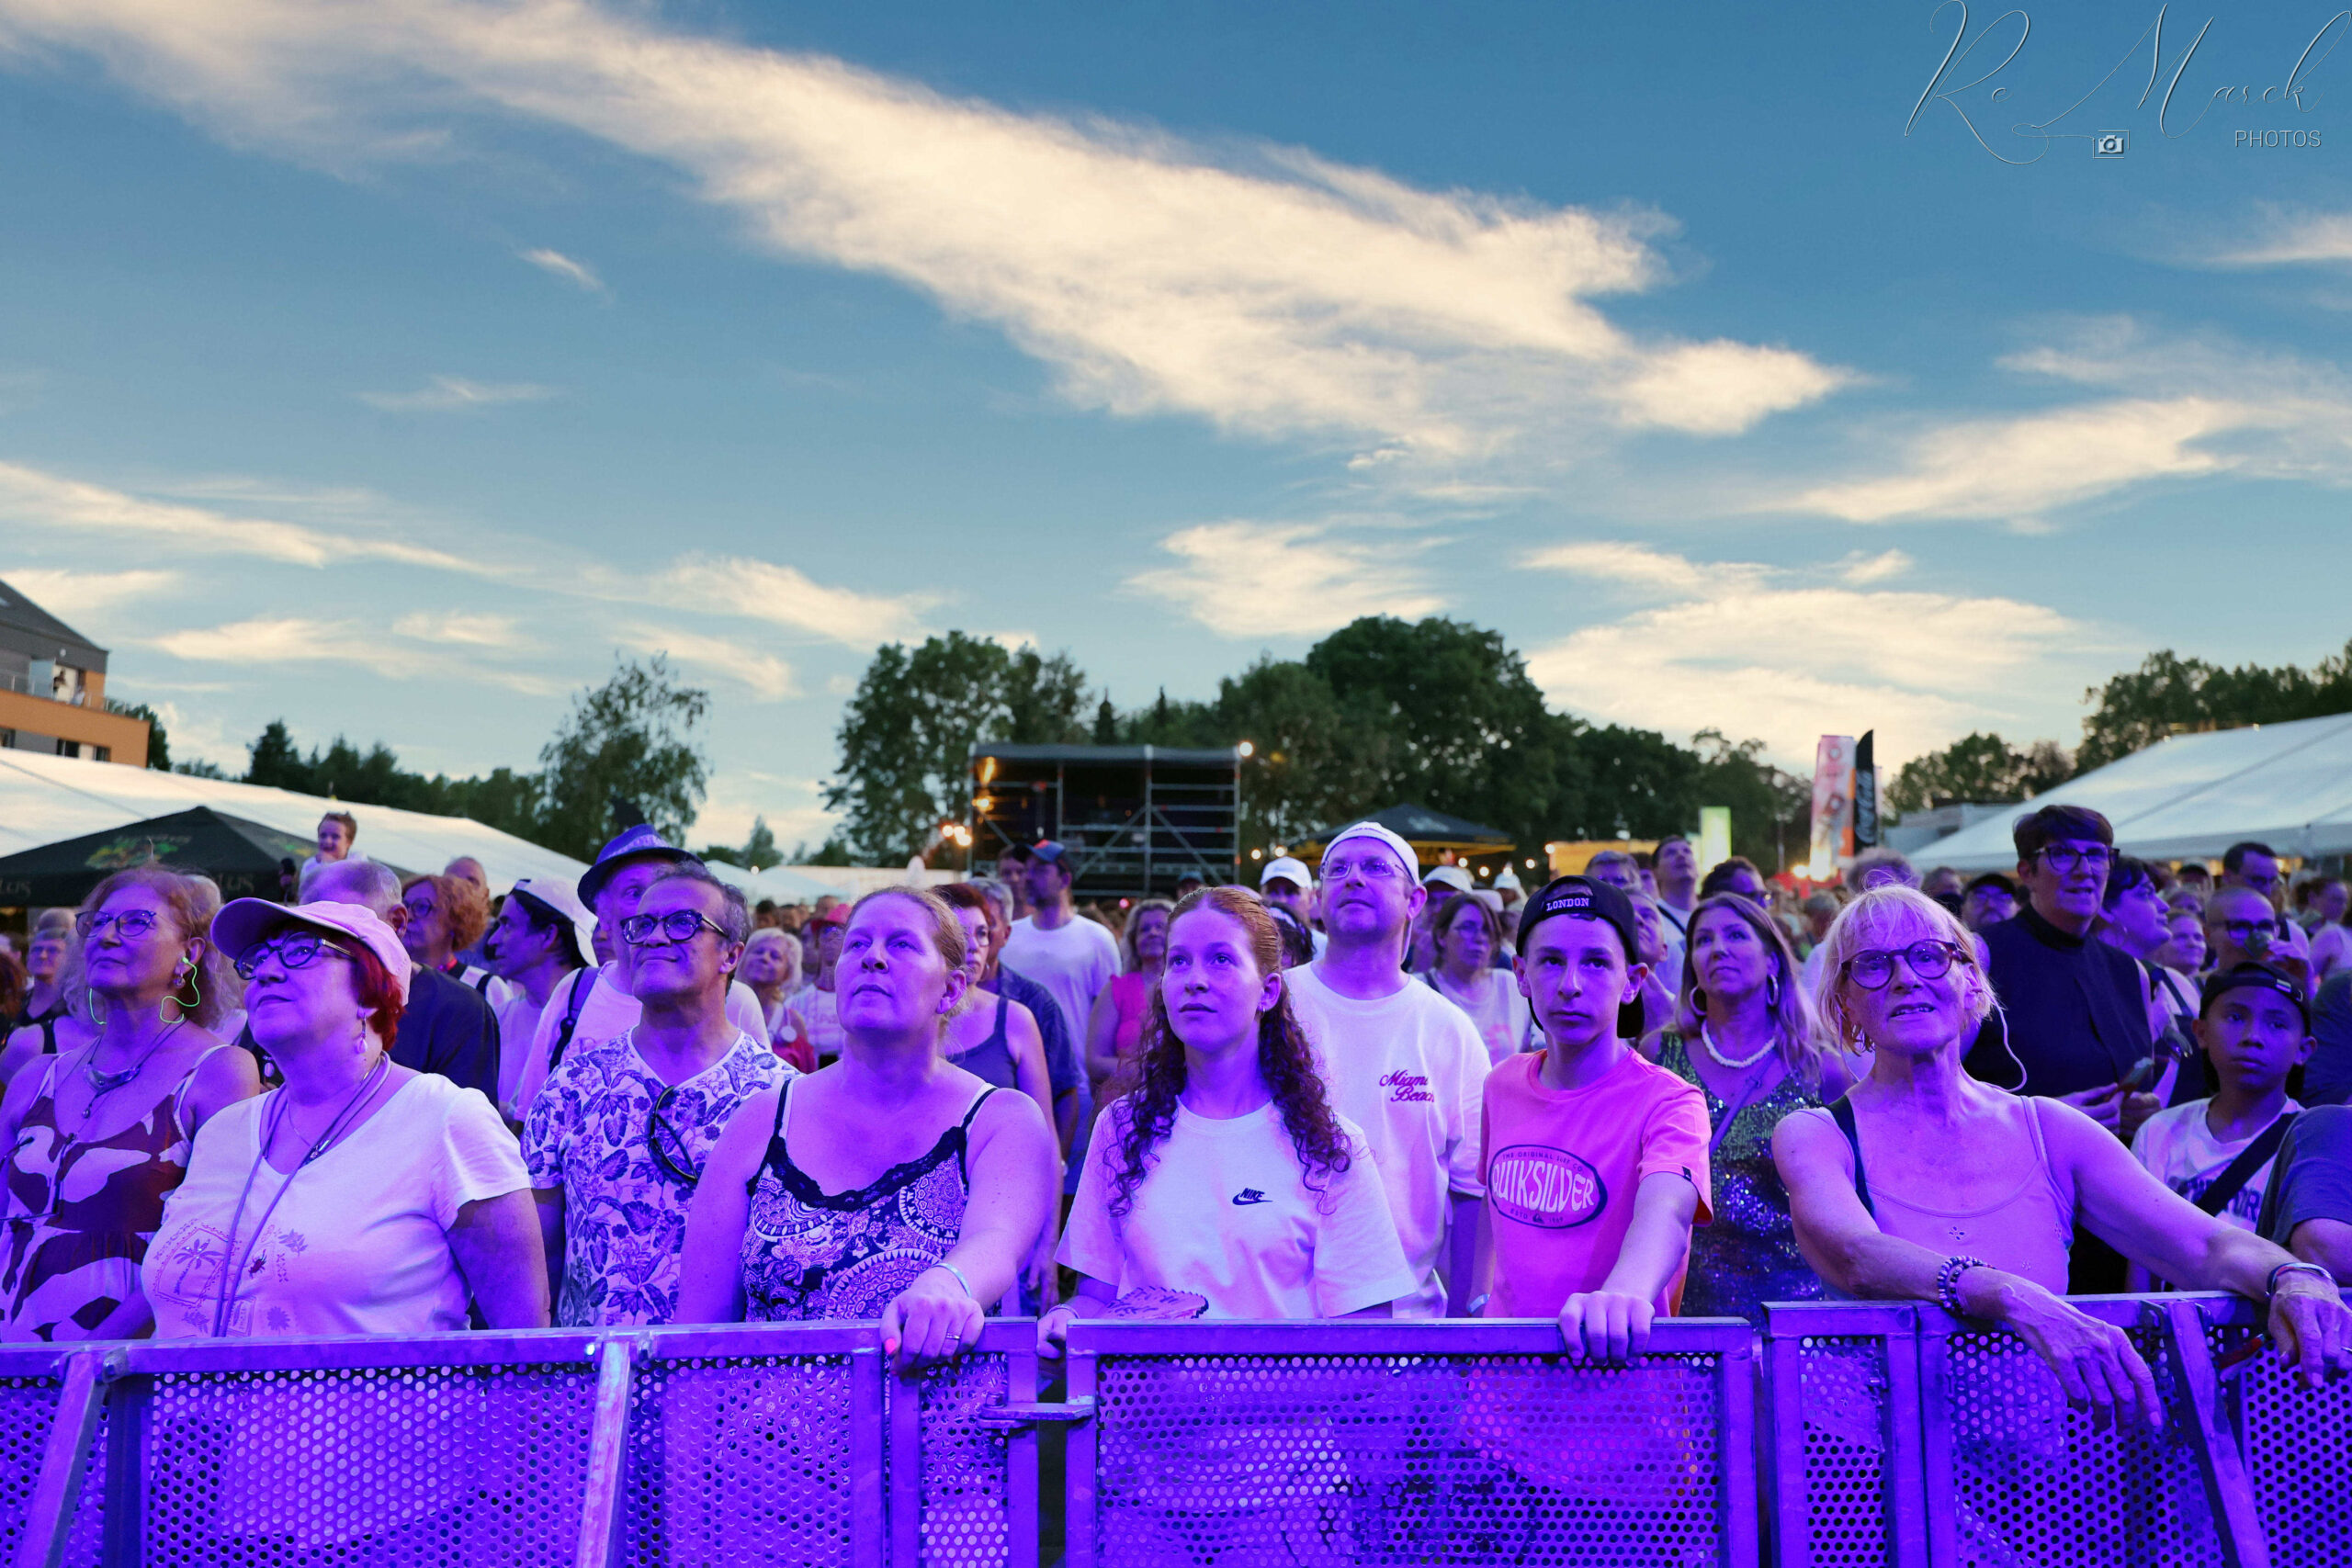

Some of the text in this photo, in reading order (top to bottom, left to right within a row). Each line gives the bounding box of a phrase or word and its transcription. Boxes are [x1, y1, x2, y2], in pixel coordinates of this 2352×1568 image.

[1546, 897, 1589, 911] LONDON
[1518, 1151, 1553, 1159] ORIGINAL
[1492, 1159, 1595, 1213] QUIKSILVER
[1239, 1187, 1266, 1201] NIKE
